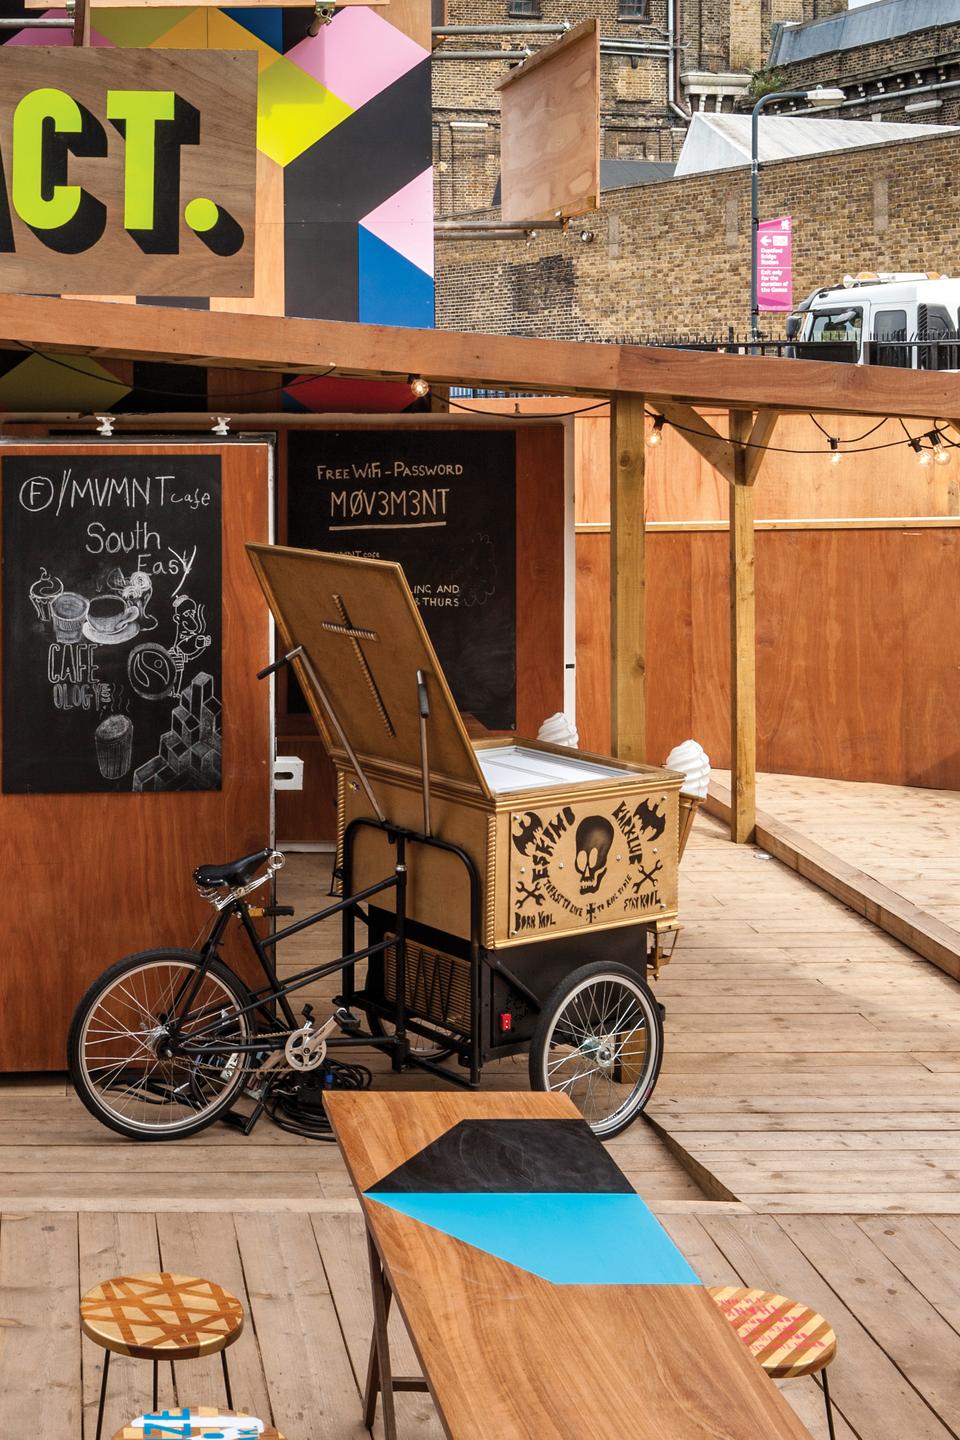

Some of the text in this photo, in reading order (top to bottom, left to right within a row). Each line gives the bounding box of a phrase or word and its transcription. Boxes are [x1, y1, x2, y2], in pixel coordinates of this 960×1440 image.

[86, 521, 161, 553] South
[411, 585, 460, 594] ING AND
[423, 597, 459, 607] THURS
